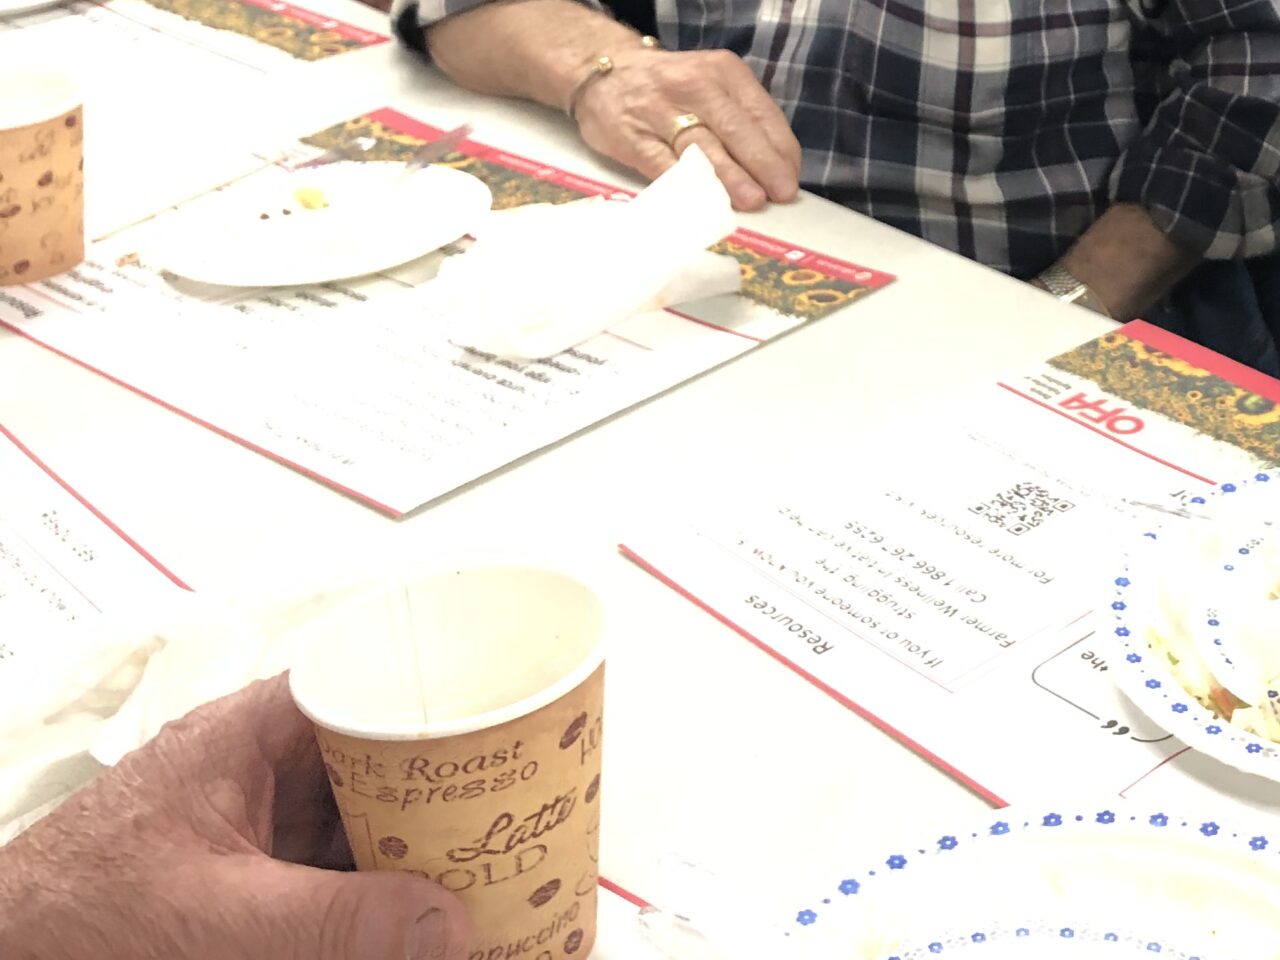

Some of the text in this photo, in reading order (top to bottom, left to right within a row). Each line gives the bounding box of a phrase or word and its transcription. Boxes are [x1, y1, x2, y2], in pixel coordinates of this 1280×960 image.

[1059, 393, 1144, 435] OFA
[986, 547, 1025, 570] more
[1026, 569, 1056, 586] For
[812, 587, 883, 630] someone
[893, 575, 960, 619] Wellness
[957, 586, 989, 605] Call
[743, 594, 835, 656] Resources
[878, 628, 901, 641] or
[958, 614, 1018, 650] Farmer
[897, 637, 933, 660] you
[922, 656, 945, 670] If
[1080, 651, 1109, 672] the
[402, 739, 524, 783] Roast
[349, 760, 539, 812] Espresso
[445, 786, 578, 864] Latte
[408, 843, 549, 892] OLD
[467, 900, 580, 960] ppuccino
